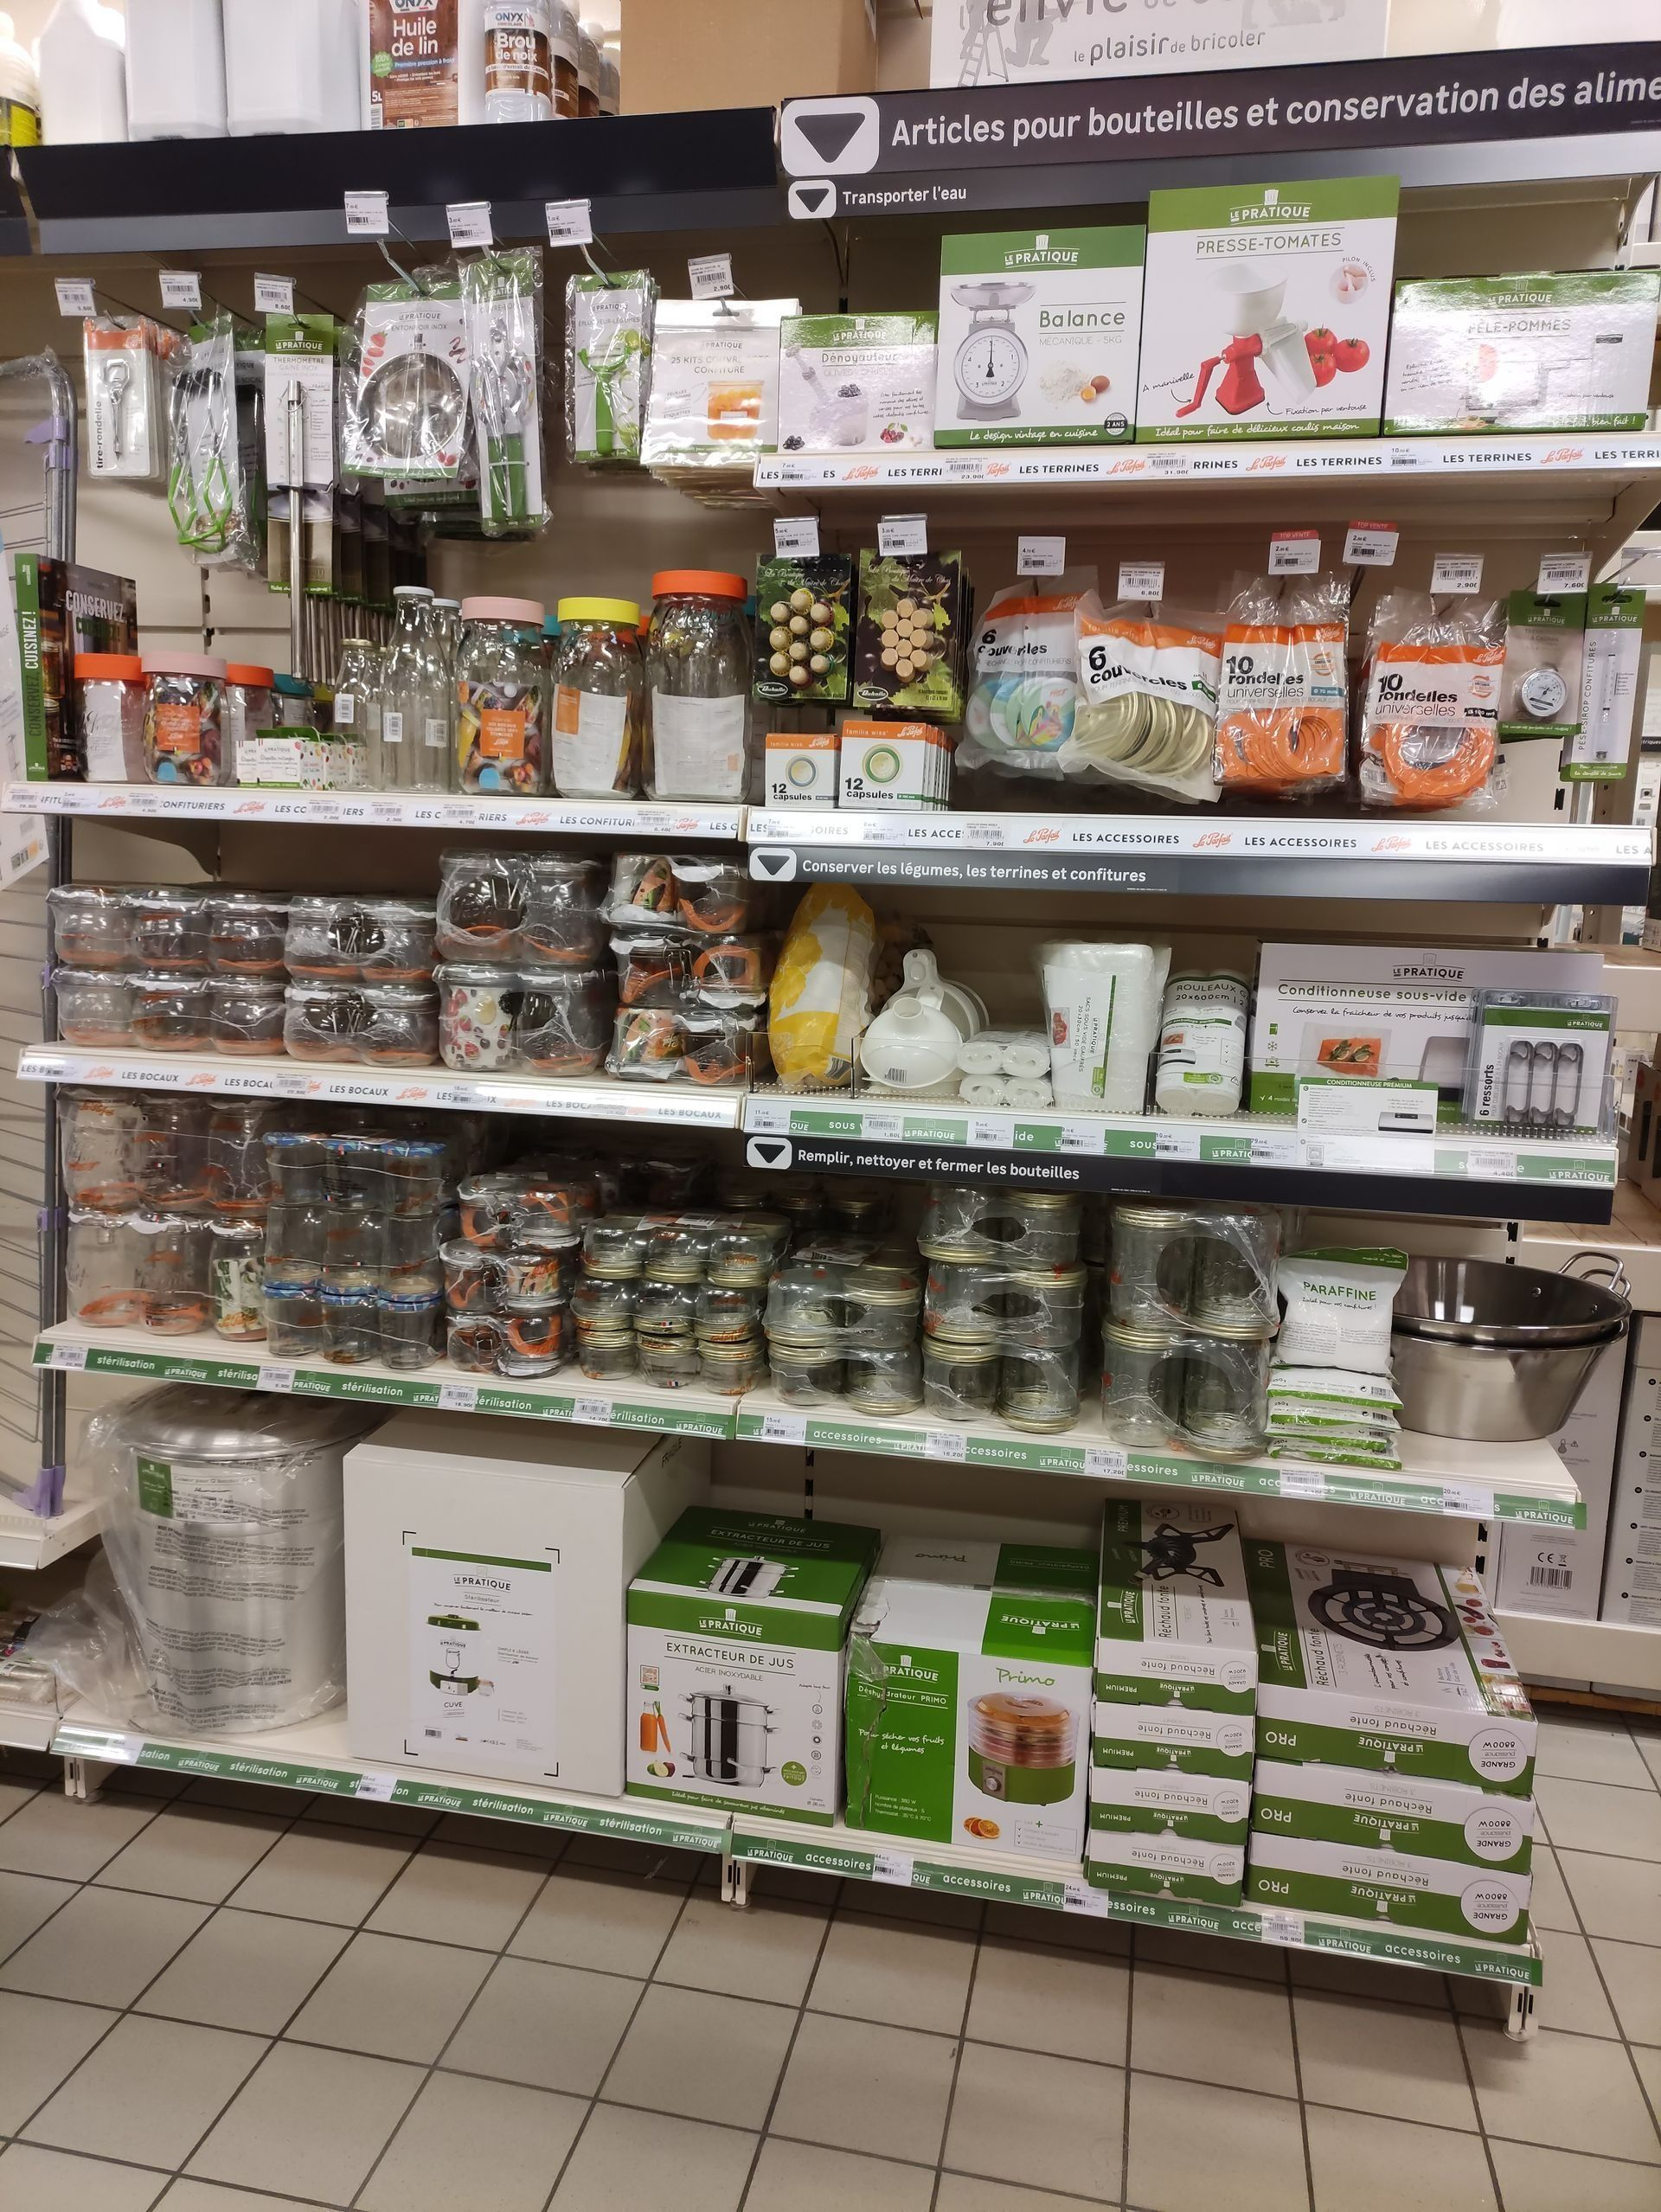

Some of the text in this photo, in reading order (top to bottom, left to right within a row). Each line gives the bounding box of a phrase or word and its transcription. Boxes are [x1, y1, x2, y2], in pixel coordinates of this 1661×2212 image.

[496, 13, 523, 22] ONYX
[393, 19, 437, 37] Huile
[391, 39, 439, 57] de lin
[496, 34, 535, 49] Brou
[1074, 29, 1267, 66] le plaisir de bricoler
[512, 51, 538, 62] noix
[891, 114, 1005, 146] Articles
[1012, 112, 1081, 147] pour
[1088, 99, 1239, 137] bouteilles
[1247, 97, 1278, 127] et
[1286, 82, 1499, 125] conservation
[1508, 78, 1566, 110] des
[843, 186, 967, 208] Transporter l'eau
[1242, 207, 1311, 220] PRATIQUE
[1196, 233, 1342, 253] PRESSE-TOMATES
[1016, 251, 1079, 264] PRATIQUE
[1040, 311, 1126, 328] Balance
[683, 356, 703, 364] KITS
[1152, 372, 1195, 388] manivelle
[970, 430, 980, 440] Le
[986, 430, 1012, 444] design
[1014, 430, 1046, 443] vintage
[1064, 428, 1098, 439] cuisine
[1156, 427, 1181, 437] Idéal
[1183, 428, 1204, 439] pour
[1207, 425, 1229, 436] faire
[1233, 425, 1244, 433] de
[1247, 424, 1288, 433] délicieux
[1292, 422, 1318, 432] coulis
[1296, 456, 1382, 468] LES TERRINES
[1443, 452, 1532, 464] LES TERRINES
[1019, 463, 1100, 474] LES TERRINES
[22, 618, 38, 670] CUISINEZ
[982, 630, 997, 644] 6
[1088, 645, 1106, 671] 6
[1226, 656, 1254, 674] 10
[1584, 641, 1596, 696] CONFITURES
[1228, 672, 1304, 685] rondelles
[1377, 673, 1403, 691] 10
[1227, 686, 1304, 698] universelles
[1378, 689, 1458, 703] rondelles
[1376, 703, 1456, 716] universelles
[772, 783, 786, 793] 12
[845, 778, 863, 790] 12
[773, 792, 812, 801] capsules
[846, 790, 894, 800] capsules
[1073, 832, 1181, 844] LES ACCESSOIRES
[1244, 837, 1357, 849] LES ACCESSOIRES
[1451, 840, 1544, 852] ACCESSOIRES
[802, 859, 1146, 882] Conserver les légumes, les terrines et confitures
[1403, 968, 1464, 979] PRATIQUE
[1279, 984, 1466, 1002] Conditionneuse sous-vide
[140, 1073, 179, 1082] BOCAUX
[1482, 1064, 1494, 1106] ressorts
[348, 1086, 388, 1097] BOCAUX
[677, 1108, 721, 1119] BOCAUX
[798, 1149, 1080, 1180] Remplir, nettoyer et fermer les bouteilles
[1303, 1281, 1376, 1301] PARAFFINE
[97, 1356, 155, 1370] stérilisation
[342, 1381, 403, 1397] stérilisation
[813, 1429, 882, 1445] accessoires
[462, 1577, 511, 1591] PRATIQUE
[709, 1619, 763, 1636] PRATIQUE
[666, 1643, 794, 1669] EXTRACTEUR DE JUS
[695, 1665, 764, 1681] ACIER INOXYDABLE
[996, 1667, 1056, 1687] Primo
[921, 1695, 946, 1704] PRIMO
[1350, 1715, 1437, 1735] Réchaud fonte
[882, 1731, 945, 1745] sécher vos fruits
[1266, 1731, 1297, 1747] PRO
[892, 1744, 925, 1754] légumes
[1103, 1747, 1134, 1756] PREMIUM
[229, 1761, 288, 1778] stérilisation
[472, 1798, 534, 1815] stérilisation
[1344, 1793, 1433, 1814] Réchaud fonte
[1260, 1808, 1292, 1823] PRO
[600, 1818, 663, 1836] stérilisation
[805, 1852, 871, 1871] accessoires
[1132, 1850, 1204, 1868] Réchaud fonte
[942, 1874, 1012, 1893] accessoires
[1097, 1871, 1127, 1881] PREMIUM
[1342, 1864, 1429, 1887] Réchaud fonte
[1258, 1880, 1289, 1895] PRO
[1385, 1943, 1462, 1965] accessoires
